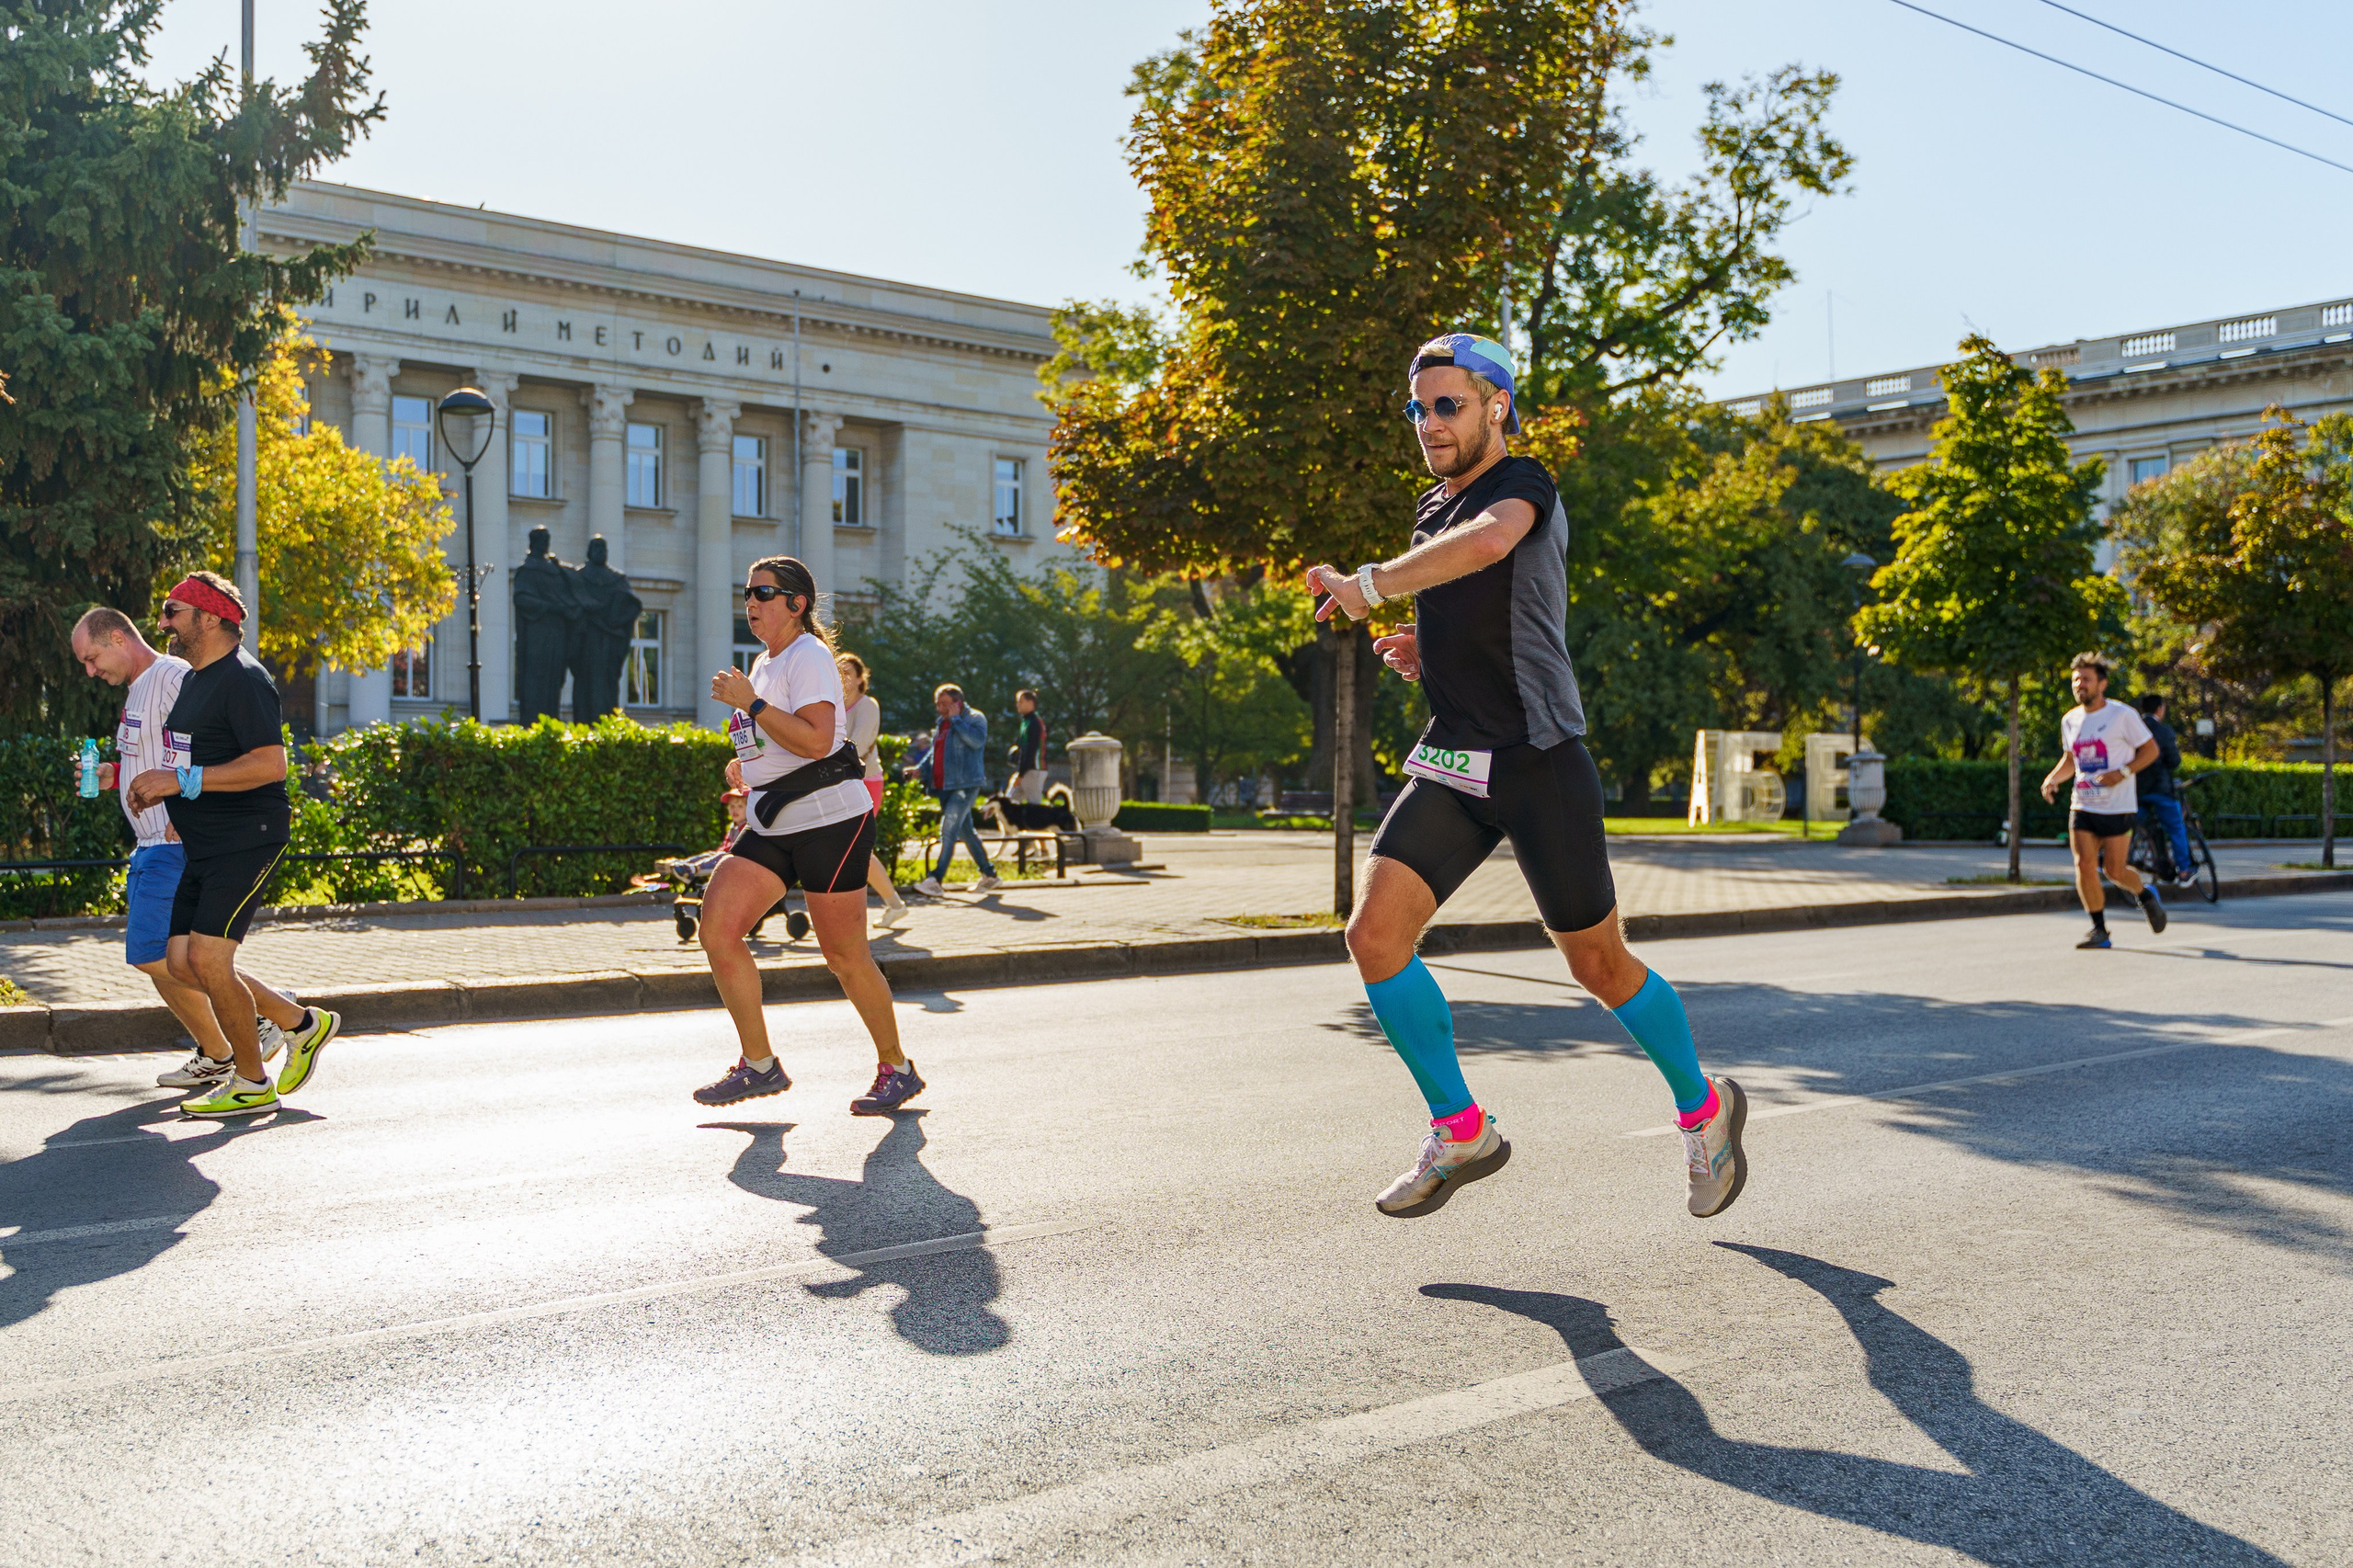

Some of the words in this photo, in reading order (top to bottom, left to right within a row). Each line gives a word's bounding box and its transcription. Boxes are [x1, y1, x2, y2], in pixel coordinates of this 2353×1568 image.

[320, 288, 460, 325] ИРИЛ
[557, 320, 783, 371] МЕТОДИЙ
[733, 730, 747, 745] 2186
[1418, 745, 1470, 774] 3202
[1433, 1117, 1464, 1127] SPORT
